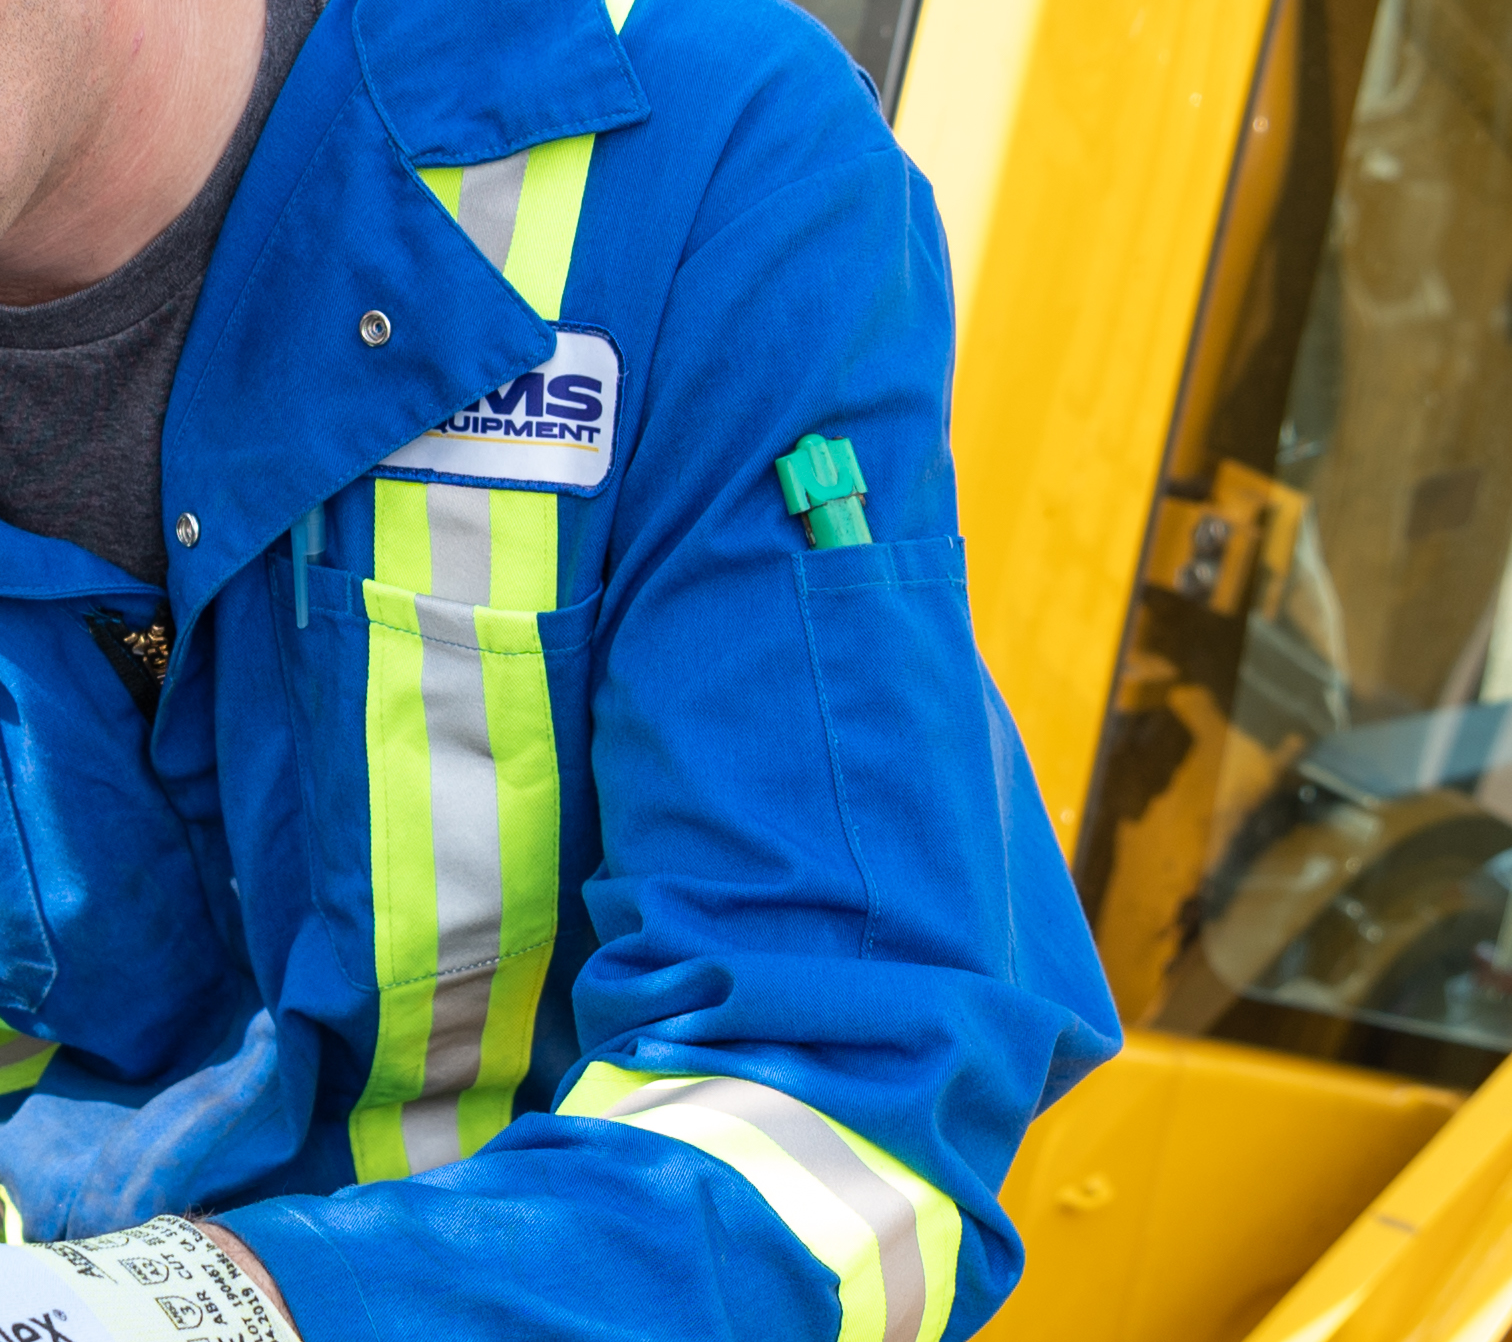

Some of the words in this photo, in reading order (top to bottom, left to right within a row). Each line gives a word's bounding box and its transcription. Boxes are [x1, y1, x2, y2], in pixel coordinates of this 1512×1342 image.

[463, 371, 603, 423] MS
[433, 414, 601, 444] QUIPMENT
[160, 1252, 193, 1280] CUT
[196, 1289, 228, 1326] ABR
